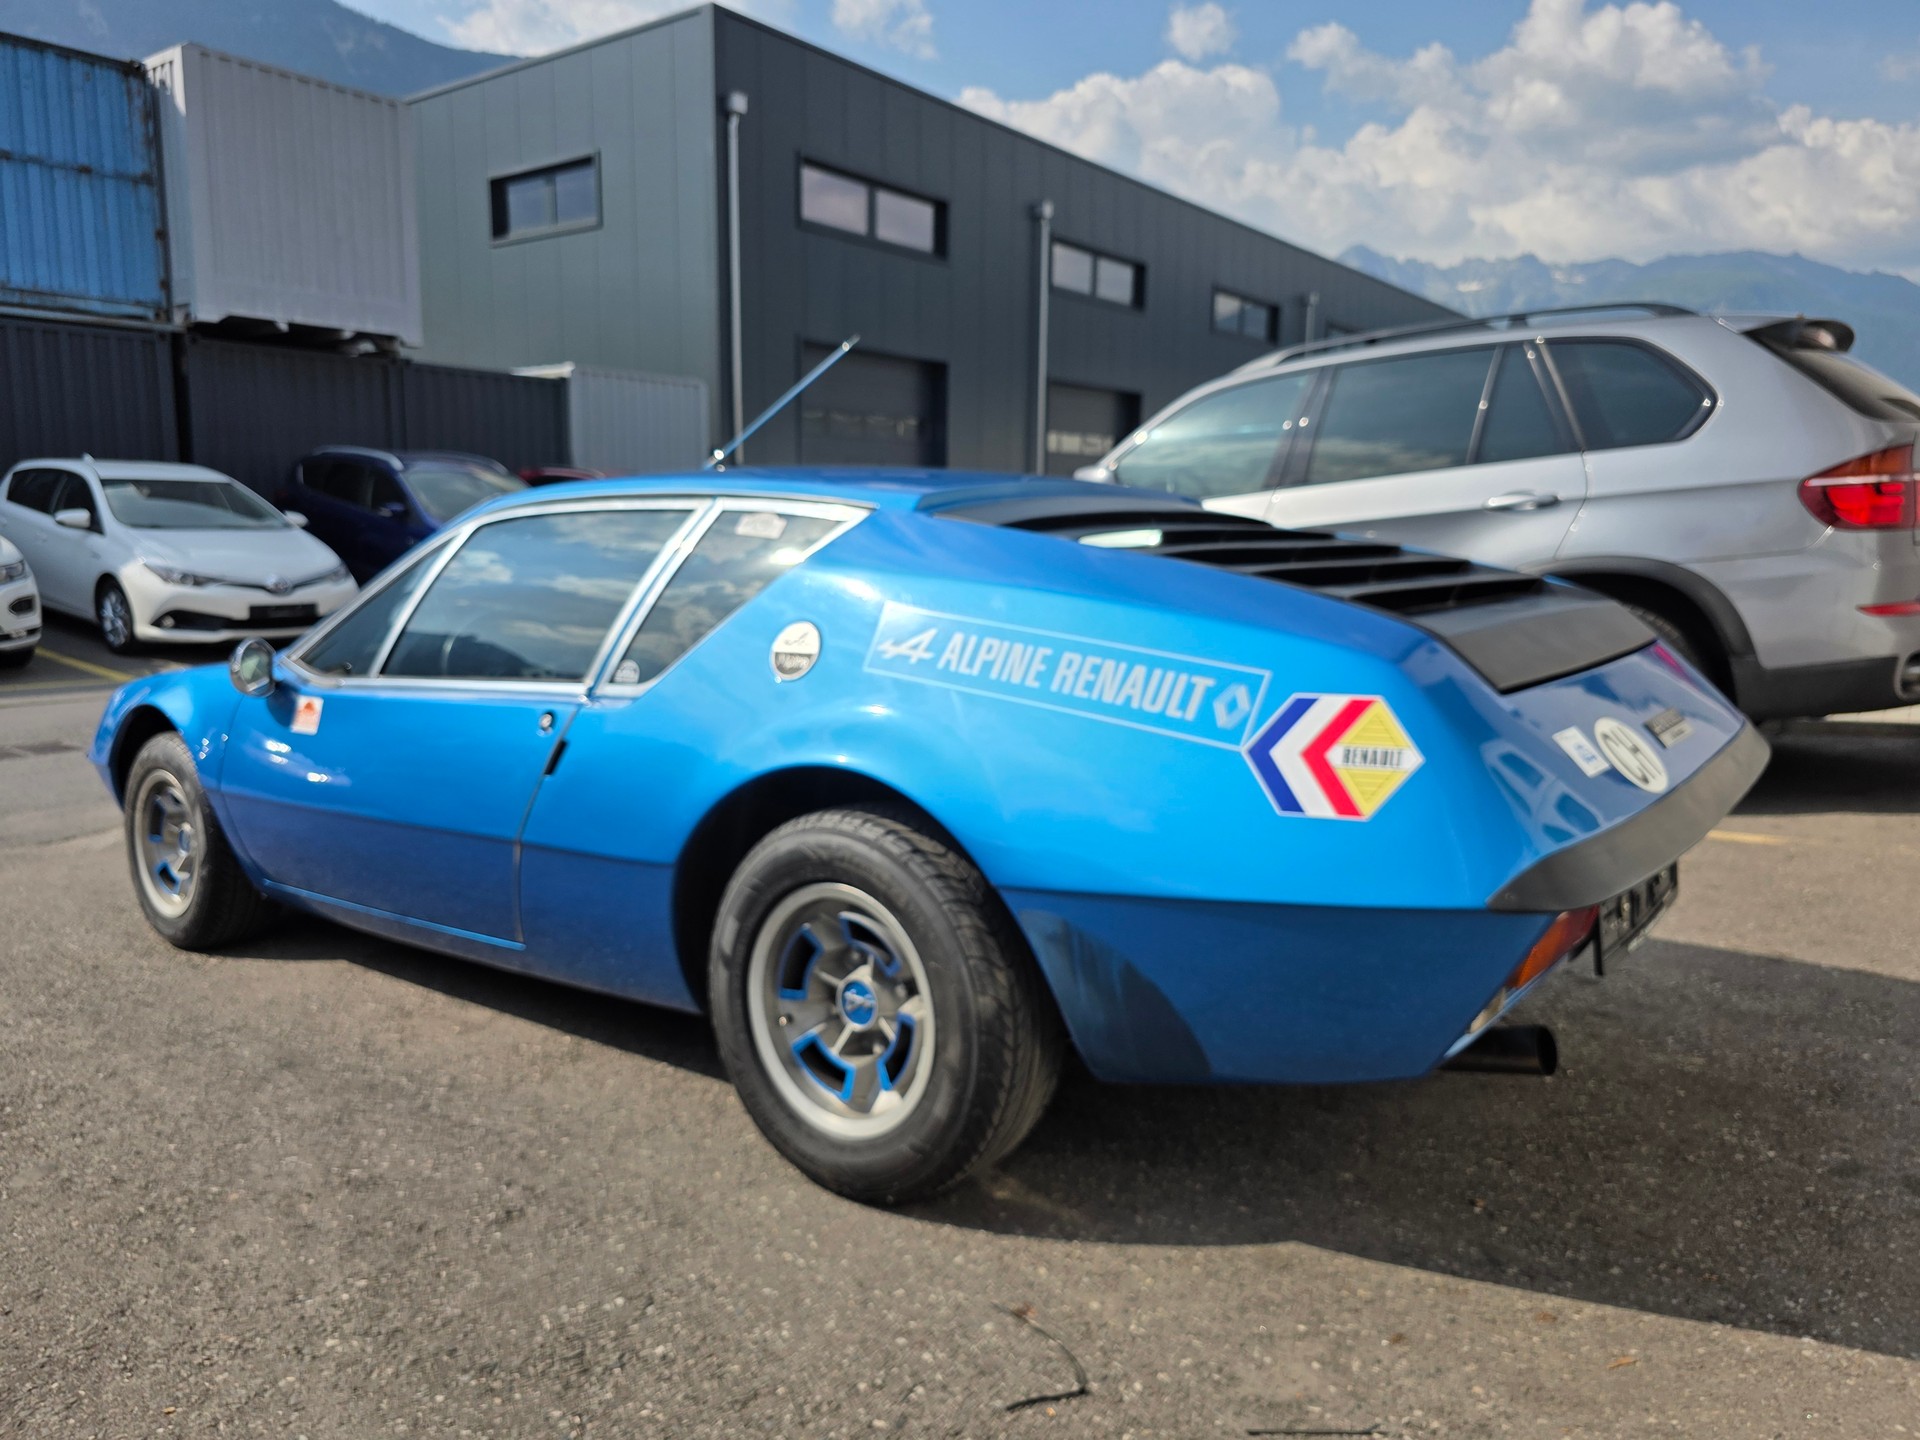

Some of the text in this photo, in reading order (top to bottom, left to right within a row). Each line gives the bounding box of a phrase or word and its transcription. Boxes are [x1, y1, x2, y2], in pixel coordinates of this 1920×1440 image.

[938, 632, 1053, 689] ALPINE
[1053, 652, 1215, 720] RENAULT
[1342, 747, 1406, 769] RENAULT
[1601, 726, 1663, 785] CH
